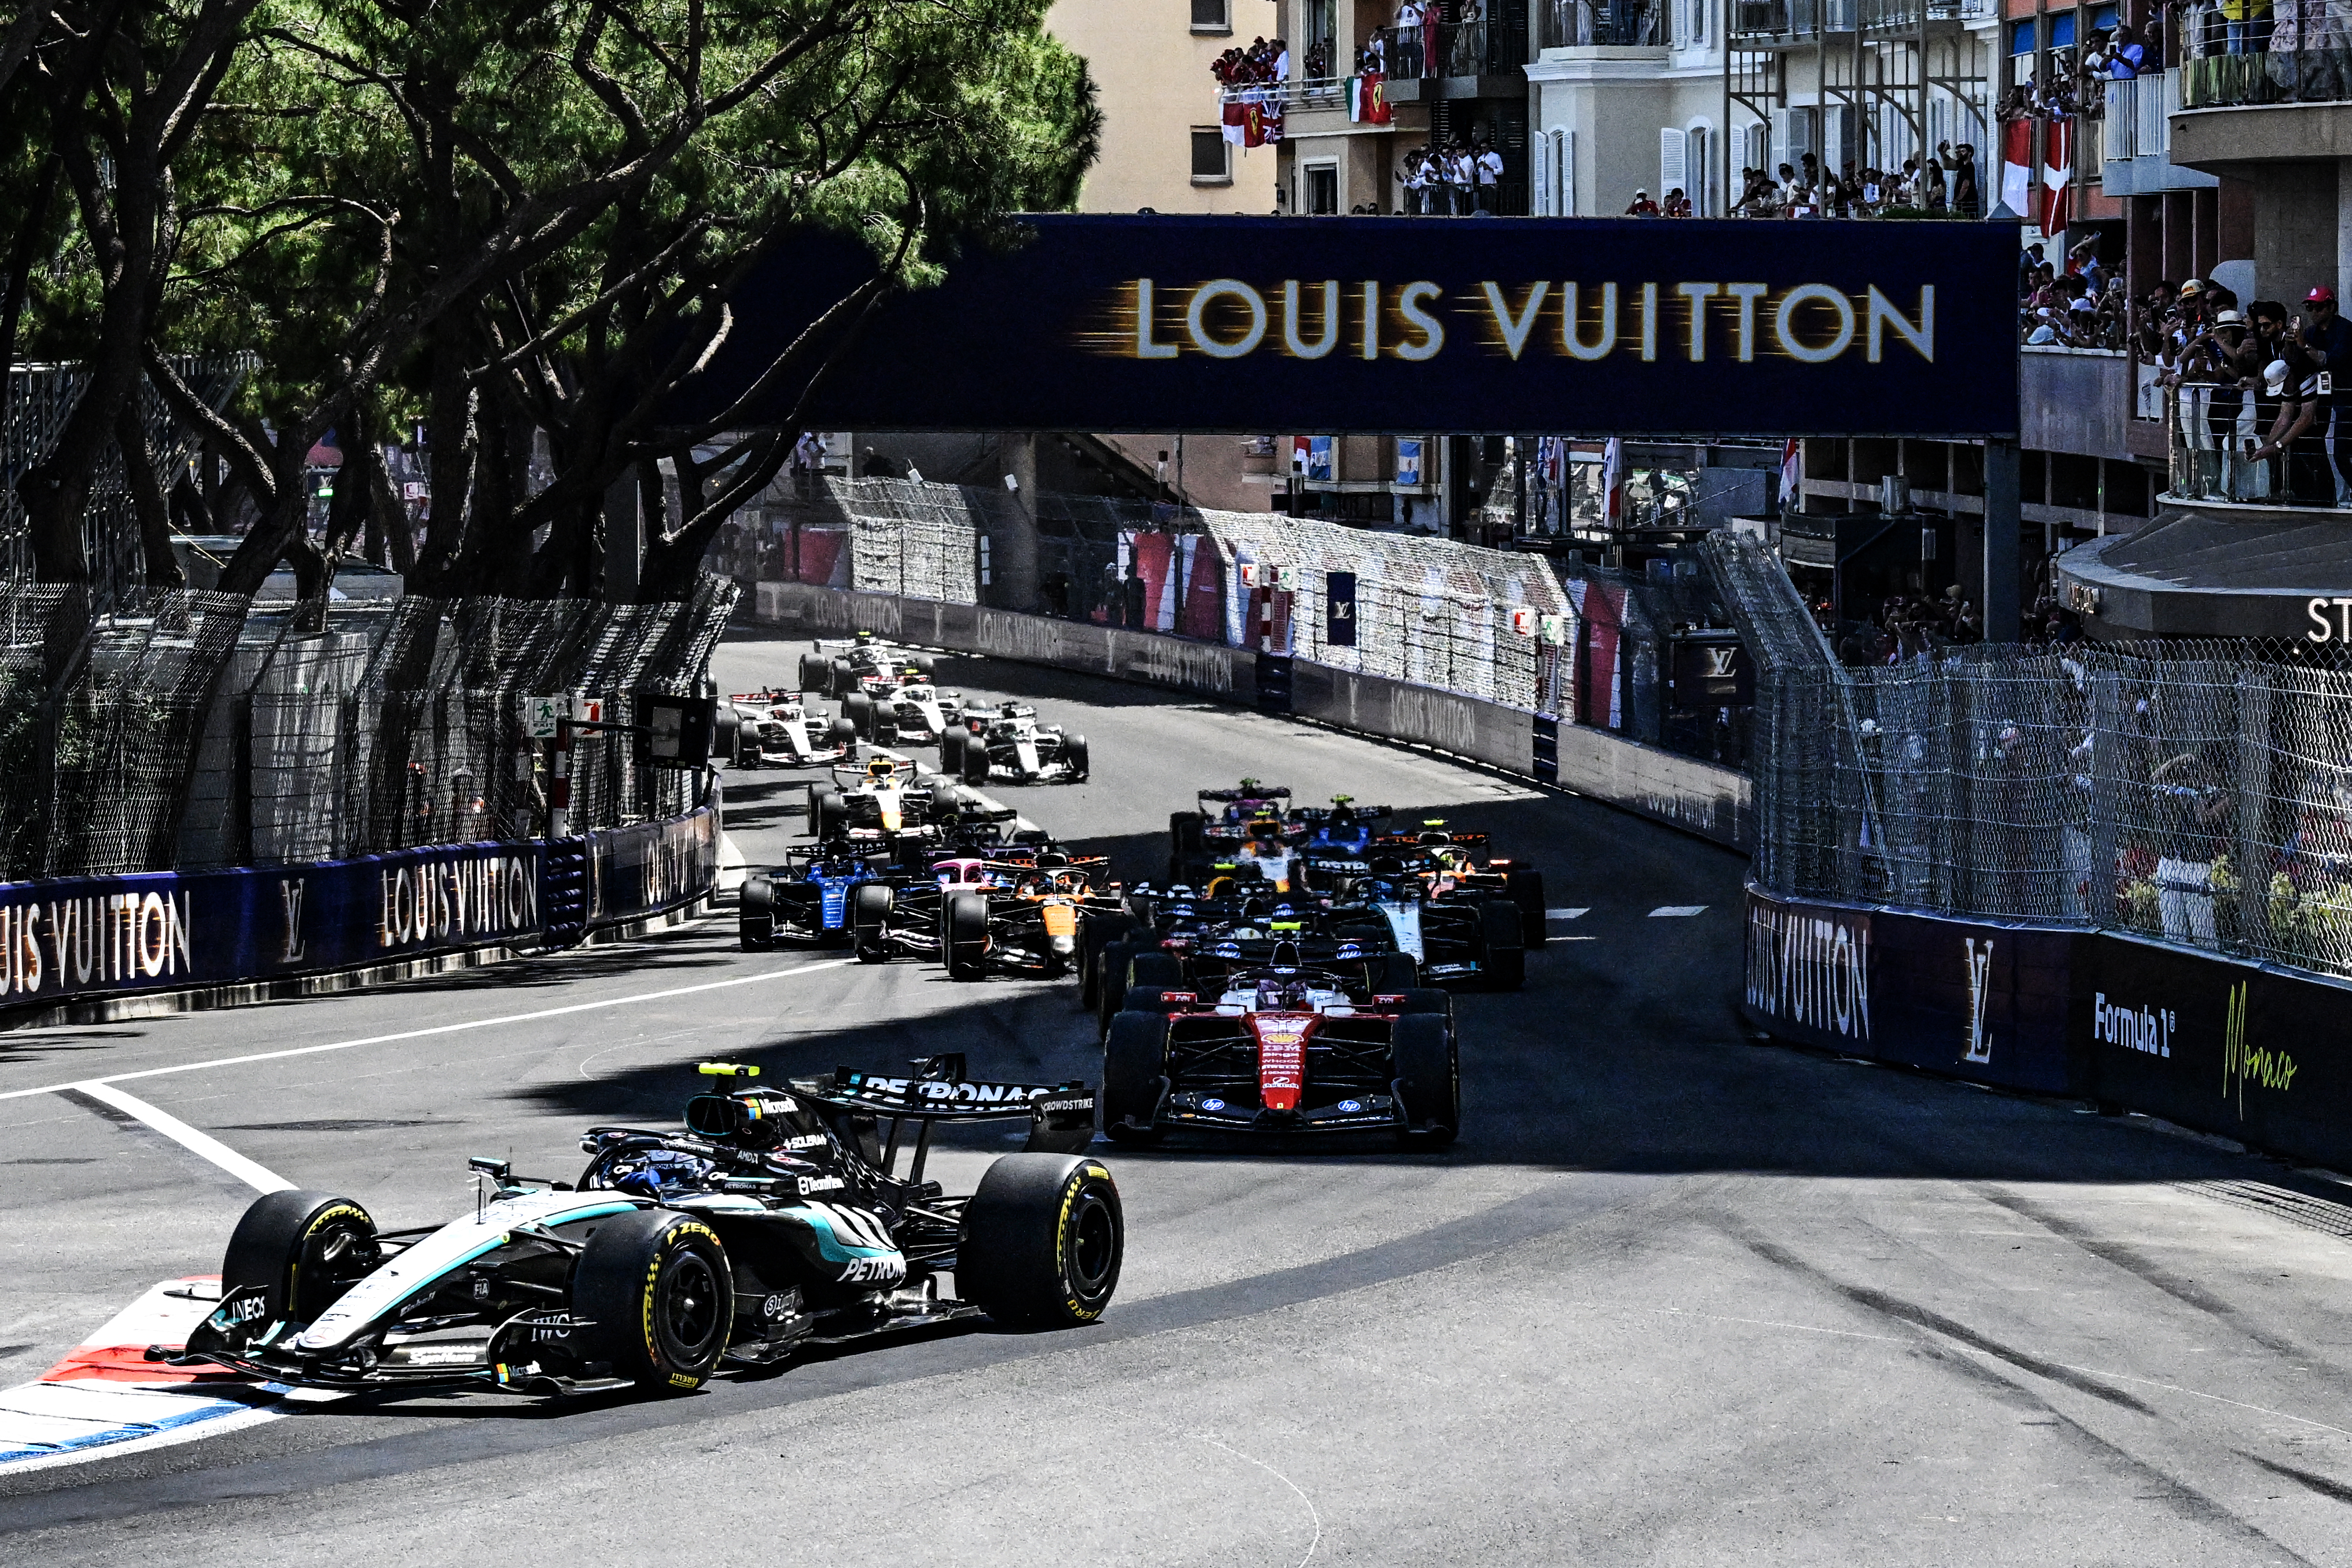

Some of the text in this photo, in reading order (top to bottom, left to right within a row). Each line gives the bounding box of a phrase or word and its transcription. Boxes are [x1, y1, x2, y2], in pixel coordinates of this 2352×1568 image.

[1137, 278, 1935, 363] LOUIS VUITTON
[383, 855, 537, 947] LOUIS VUITTON
[51, 890, 191, 988] VUITTON
[1780, 912, 1869, 1041] VUITTON
[2095, 992, 2158, 1055] Formula
[2223, 980, 2297, 1121] Monaco
[760, 1097, 799, 1114] Microsoft
[862, 1076, 1051, 1110] PETRONAS
[1043, 1098, 1093, 1112] CROWDSTRIKE
[1205, 1099, 1223, 1110] hp
[1341, 1100, 1359, 1111] hp
[737, 1150, 753, 1163] AMD
[667, 1221, 722, 1246] P ZERO
[232, 1295, 265, 1324] INEOS
[531, 1313, 571, 1342] IWC
[507, 1360, 542, 1378] Microsoft
